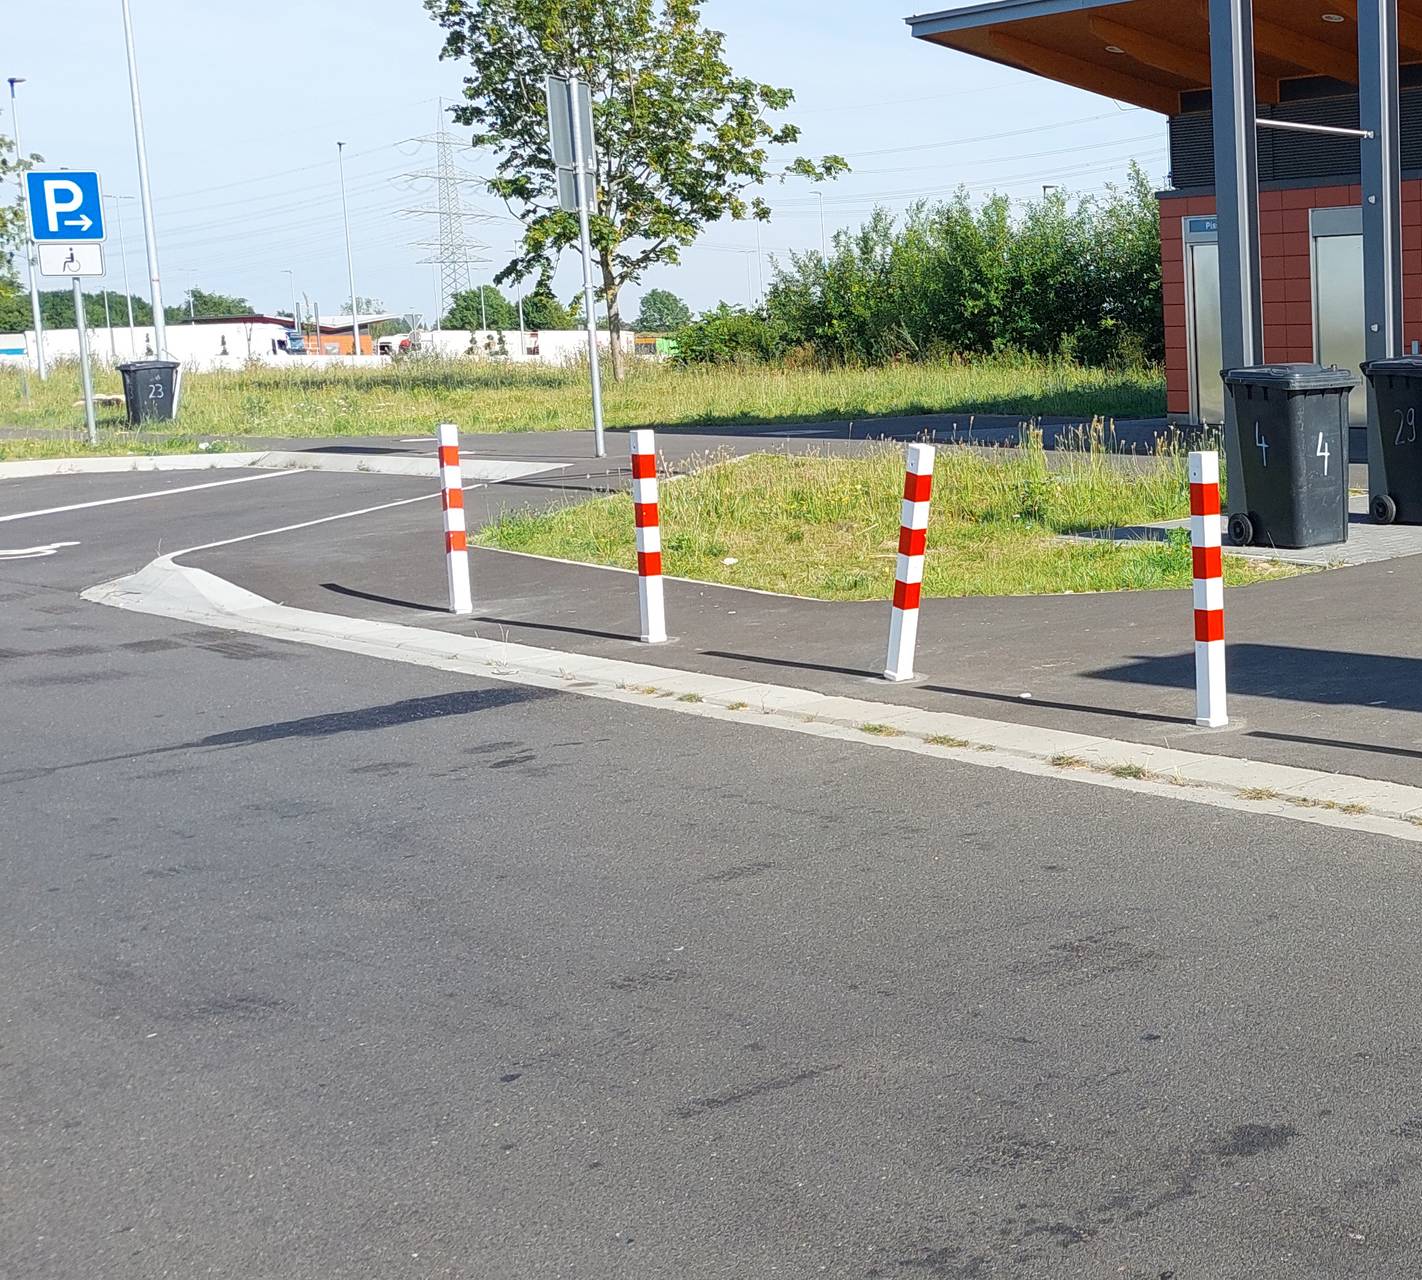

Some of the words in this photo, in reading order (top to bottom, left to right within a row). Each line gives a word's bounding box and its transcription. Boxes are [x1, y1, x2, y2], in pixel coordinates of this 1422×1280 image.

[43, 180, 83, 232] P
[148, 383, 164, 399] 23
[1255, 421, 1270, 467] 4
[1393, 407, 1416, 446] 29
[1316, 431, 1331, 476] 4
